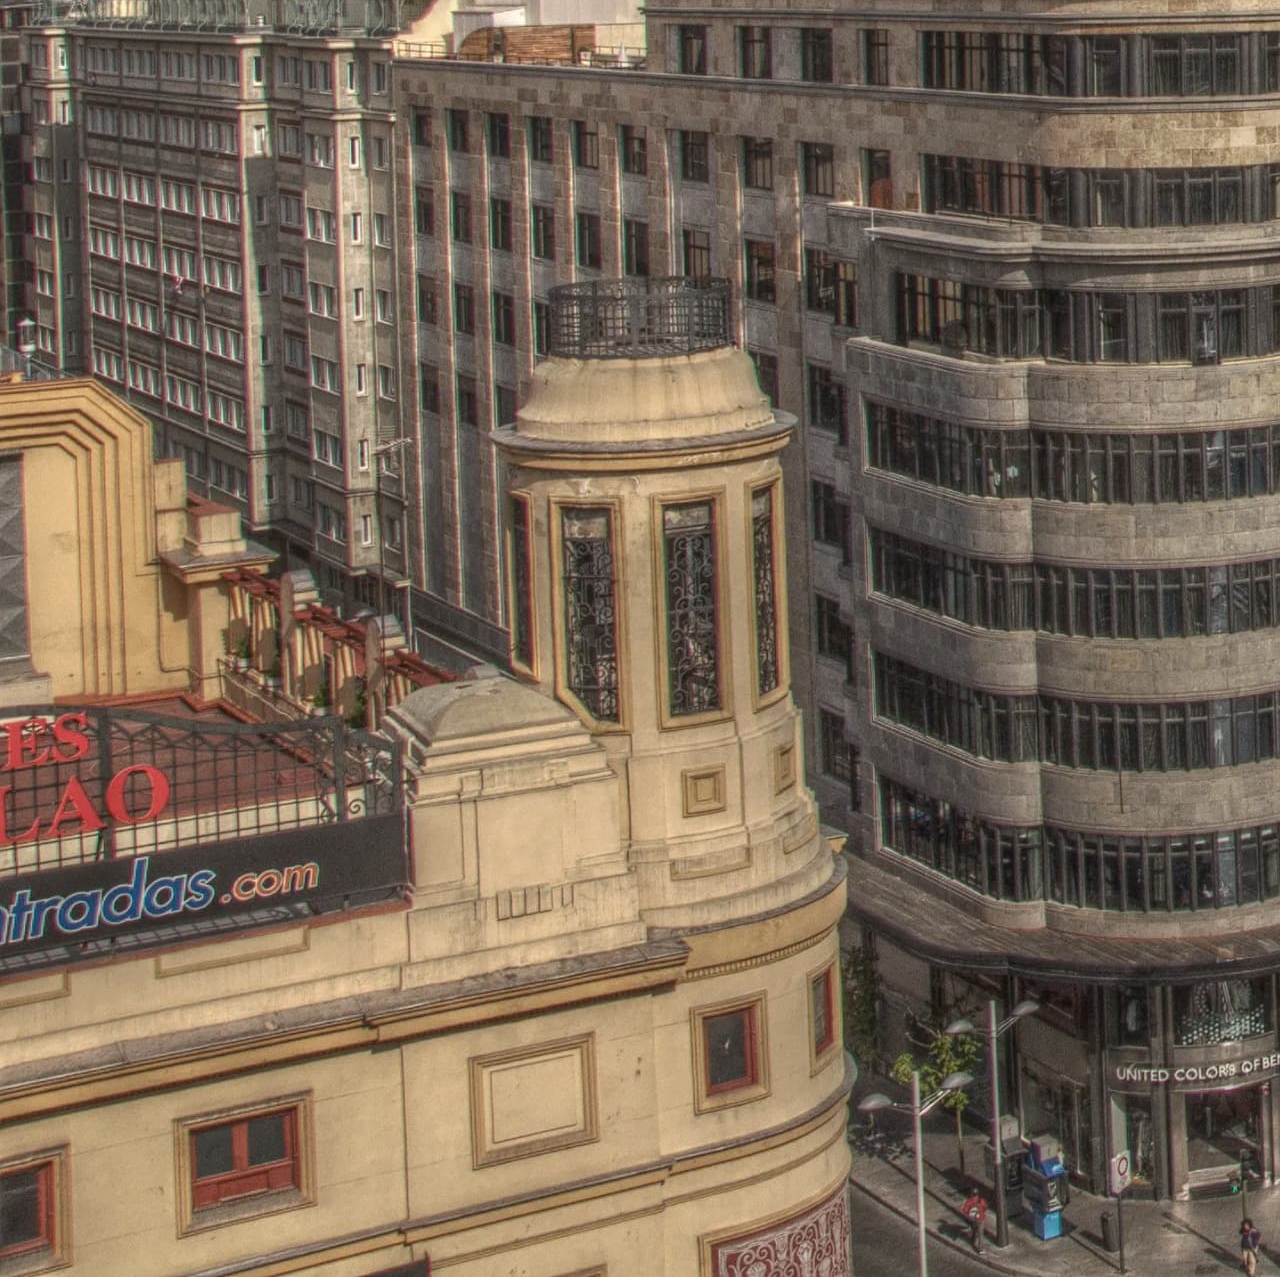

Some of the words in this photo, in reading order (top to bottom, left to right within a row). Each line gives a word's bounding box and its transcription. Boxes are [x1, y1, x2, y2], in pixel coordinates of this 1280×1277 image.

[1116, 1068, 1169, 1082] UNITED
[1174, 1063, 1236, 1081] COLORS
[1241, 1059, 1262, 1073] OF
